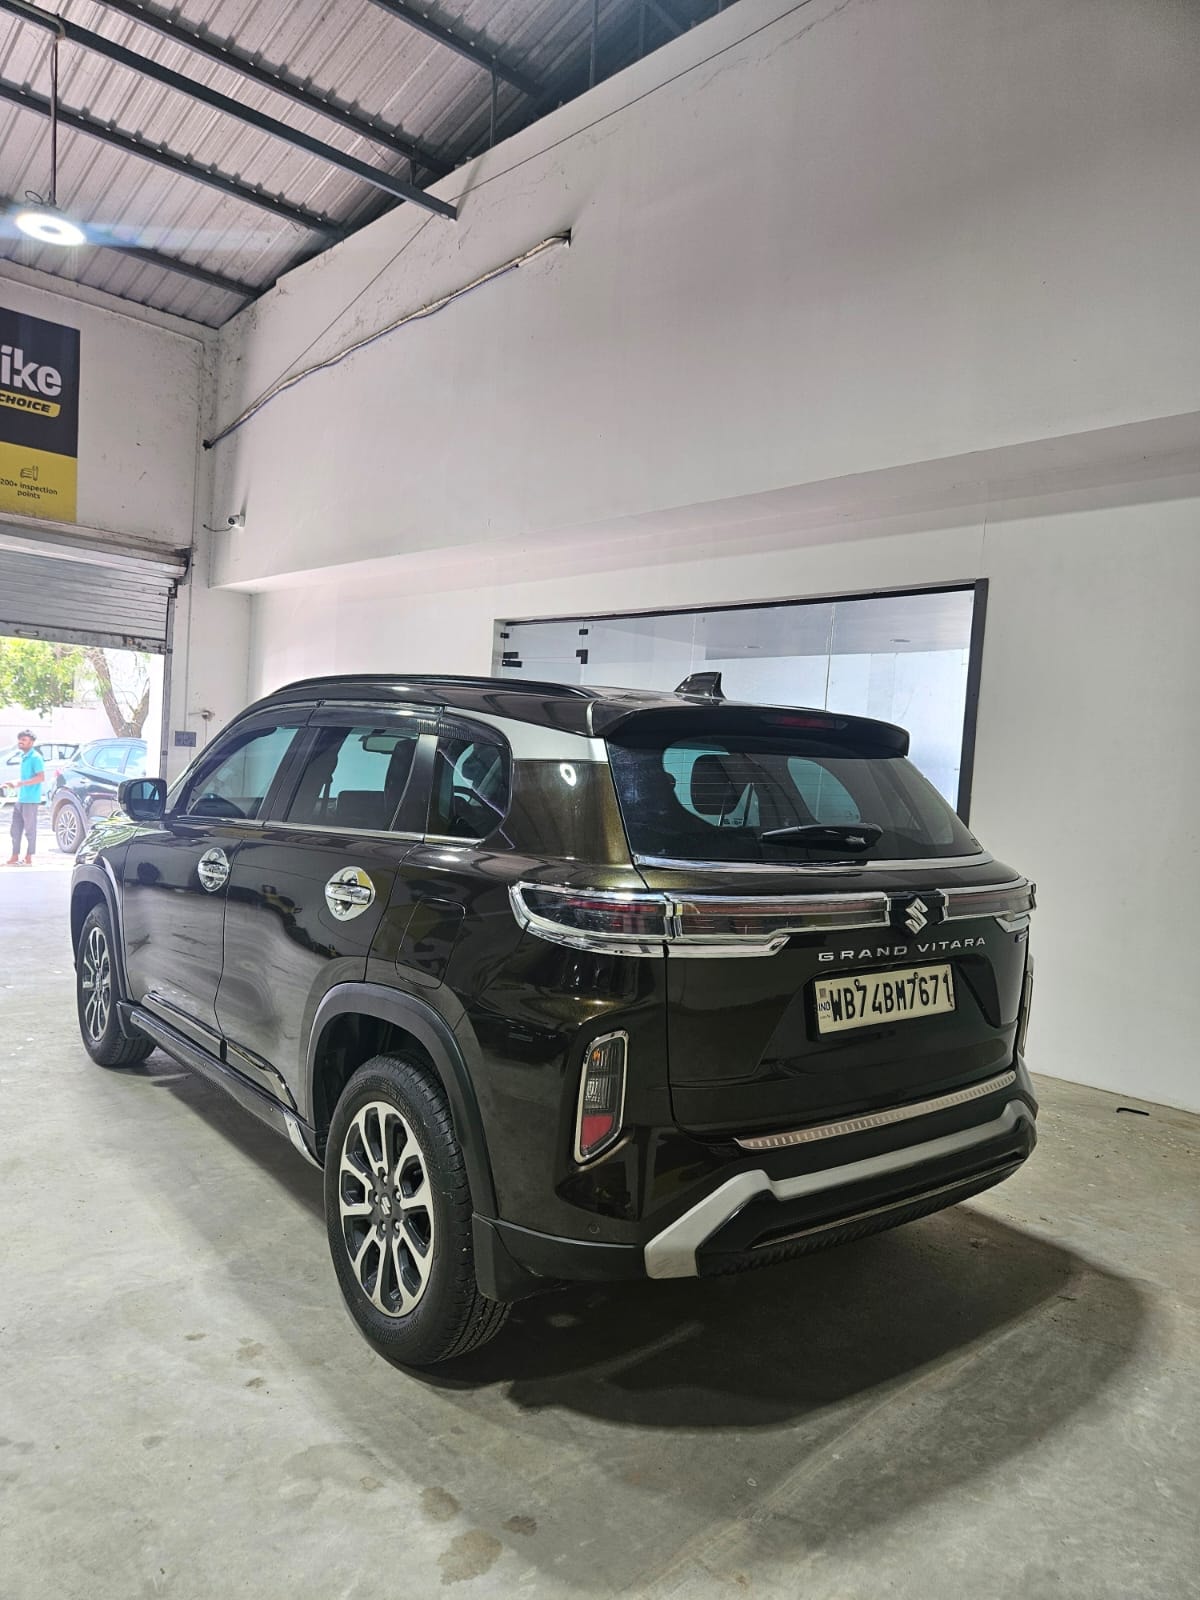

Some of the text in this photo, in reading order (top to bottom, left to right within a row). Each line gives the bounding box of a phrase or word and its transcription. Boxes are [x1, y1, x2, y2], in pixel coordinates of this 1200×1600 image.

[17, 490, 41, 500] points
[20, 481, 58, 495] inspection
[818, 937, 986, 962] GRAND VITARA
[829, 971, 953, 1022] WB74BM7671
